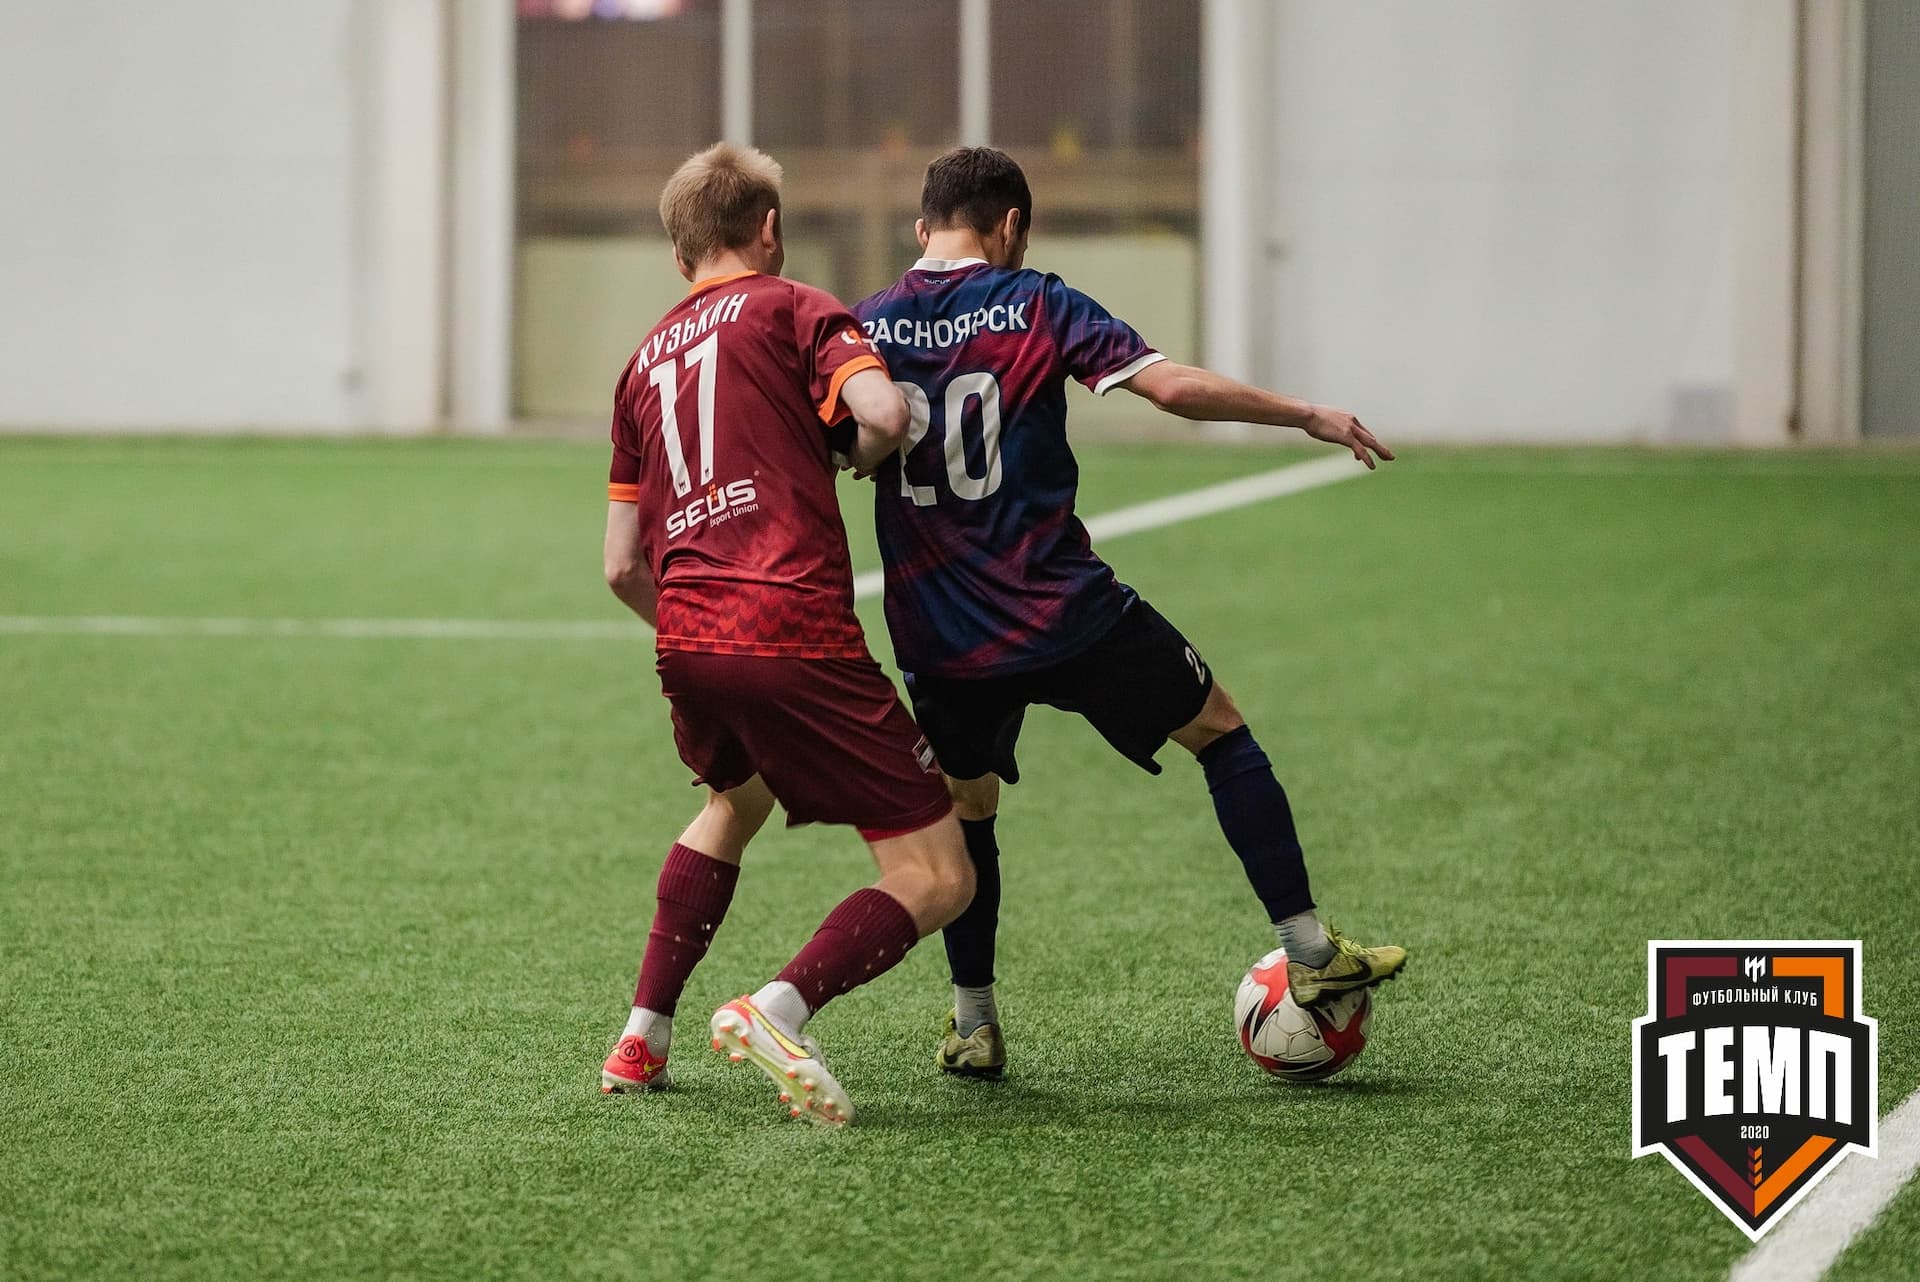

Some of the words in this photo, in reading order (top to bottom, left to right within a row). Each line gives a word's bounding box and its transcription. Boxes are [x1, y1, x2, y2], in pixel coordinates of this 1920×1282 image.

[637, 293, 749, 375] КУЗЬКИН
[649, 330, 719, 499] 17
[892, 371, 1003, 507] 20
[732, 503, 760, 518] Union
